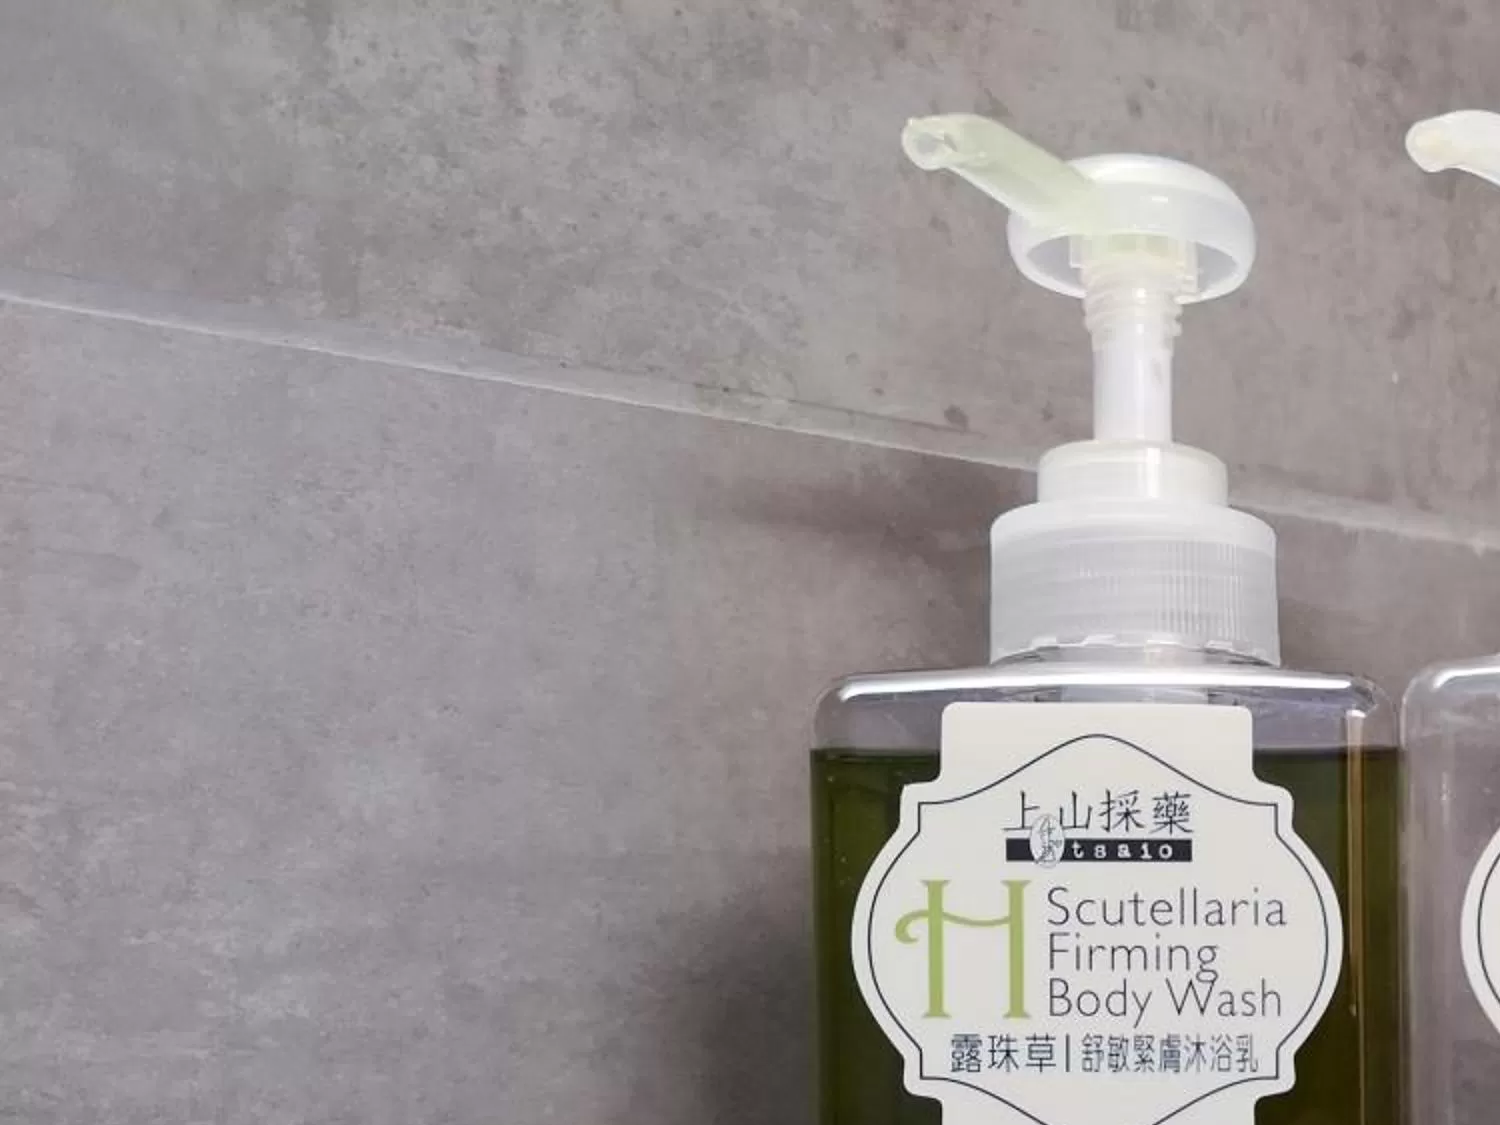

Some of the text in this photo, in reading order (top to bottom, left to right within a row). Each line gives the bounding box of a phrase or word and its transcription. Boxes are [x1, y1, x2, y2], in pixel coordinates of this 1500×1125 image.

[1002, 789, 1194, 835] 上山採藥
[1072, 841, 1173, 860] tsaio
[1046, 885, 1288, 928] Scutellaria
[895, 880, 1032, 1018] H
[1047, 931, 1220, 982] Firming
[1047, 977, 1283, 1028] Body Wash
